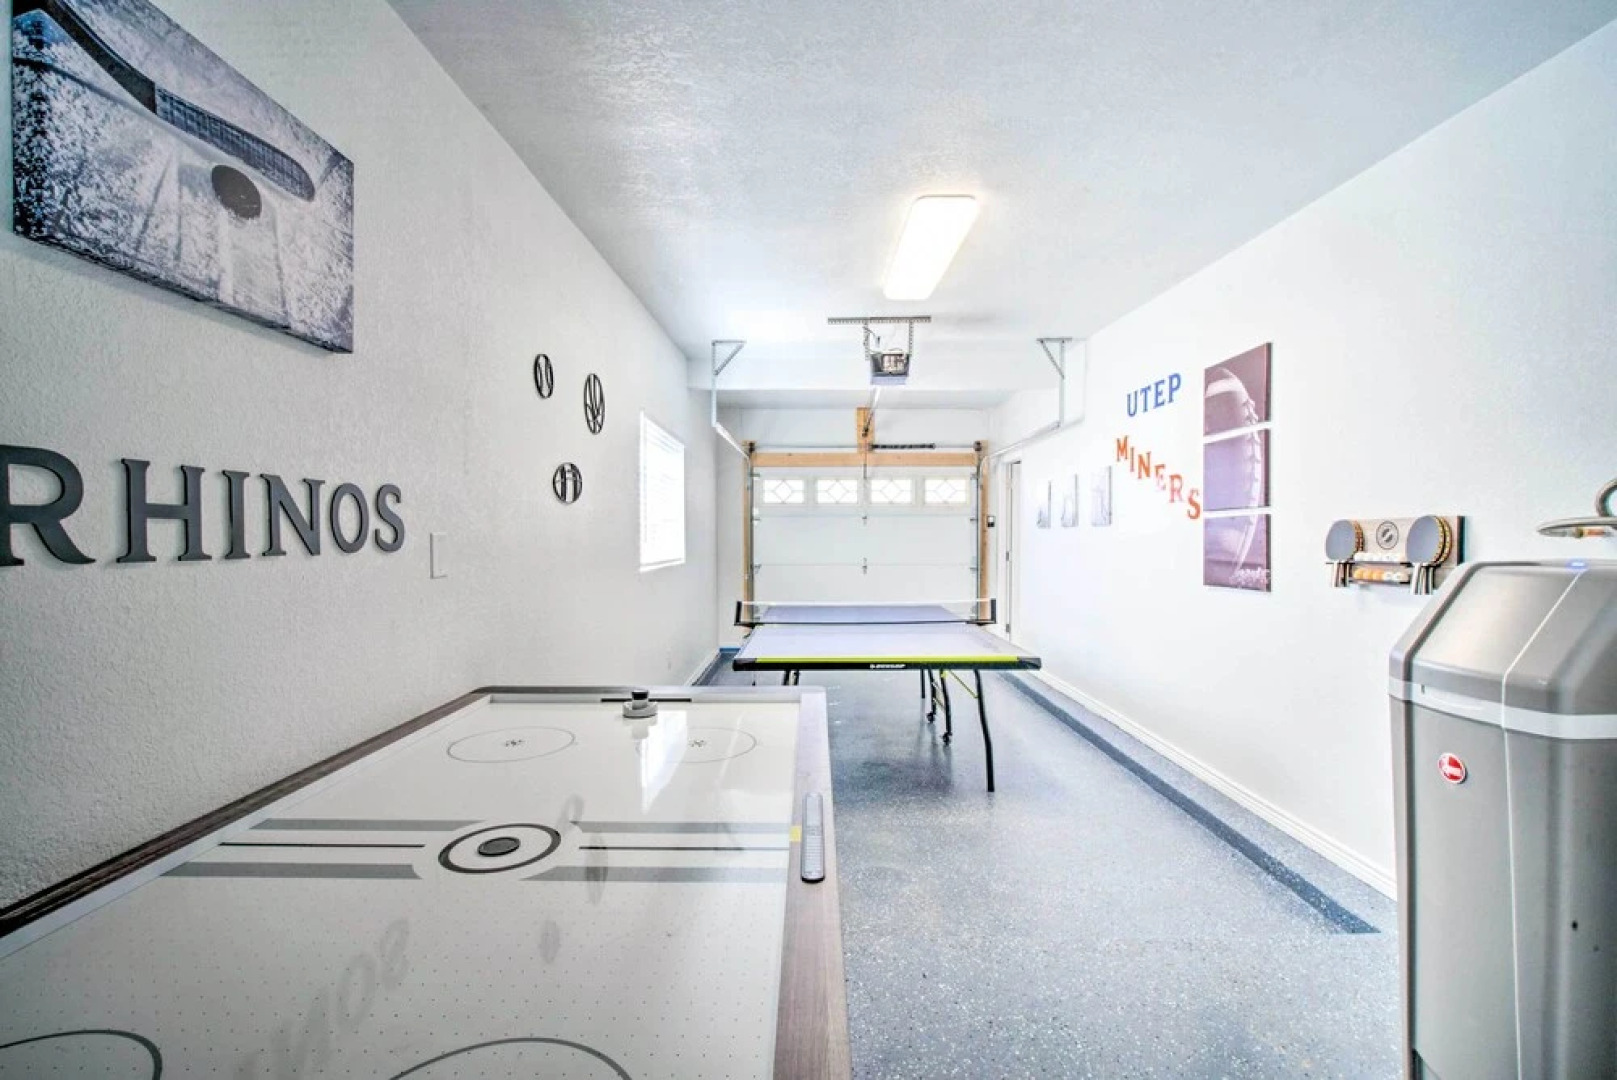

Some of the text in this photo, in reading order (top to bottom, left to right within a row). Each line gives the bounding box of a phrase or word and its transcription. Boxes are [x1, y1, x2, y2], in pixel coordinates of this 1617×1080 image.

[1127, 373, 1181, 417] UTEP
[0, 444, 406, 567] RHINOS
[1116, 435, 1201, 520] MINERS
